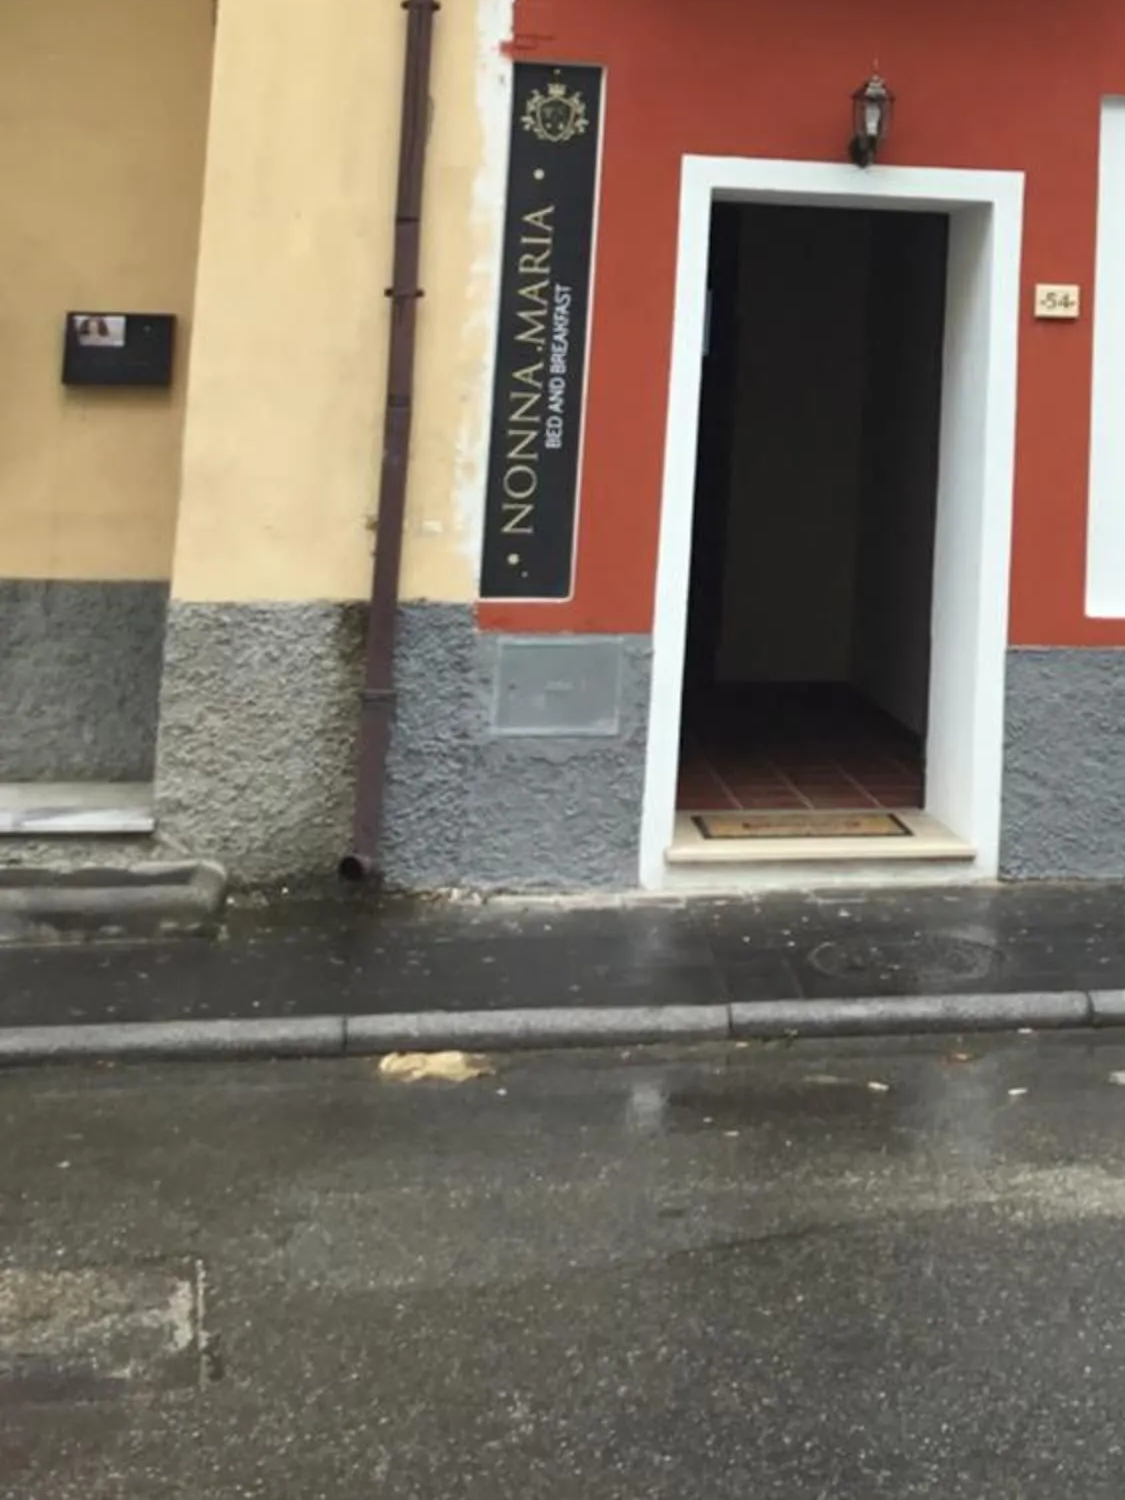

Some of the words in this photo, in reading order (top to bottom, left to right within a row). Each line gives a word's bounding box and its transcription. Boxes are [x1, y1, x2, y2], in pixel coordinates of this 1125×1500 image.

[513, 205, 556, 345] MARIA
[550, 283, 573, 375] BREAKFAST
[544, 415, 564, 449] BED
[548, 376, 567, 414] AND
[501, 361, 545, 535] NONNA
